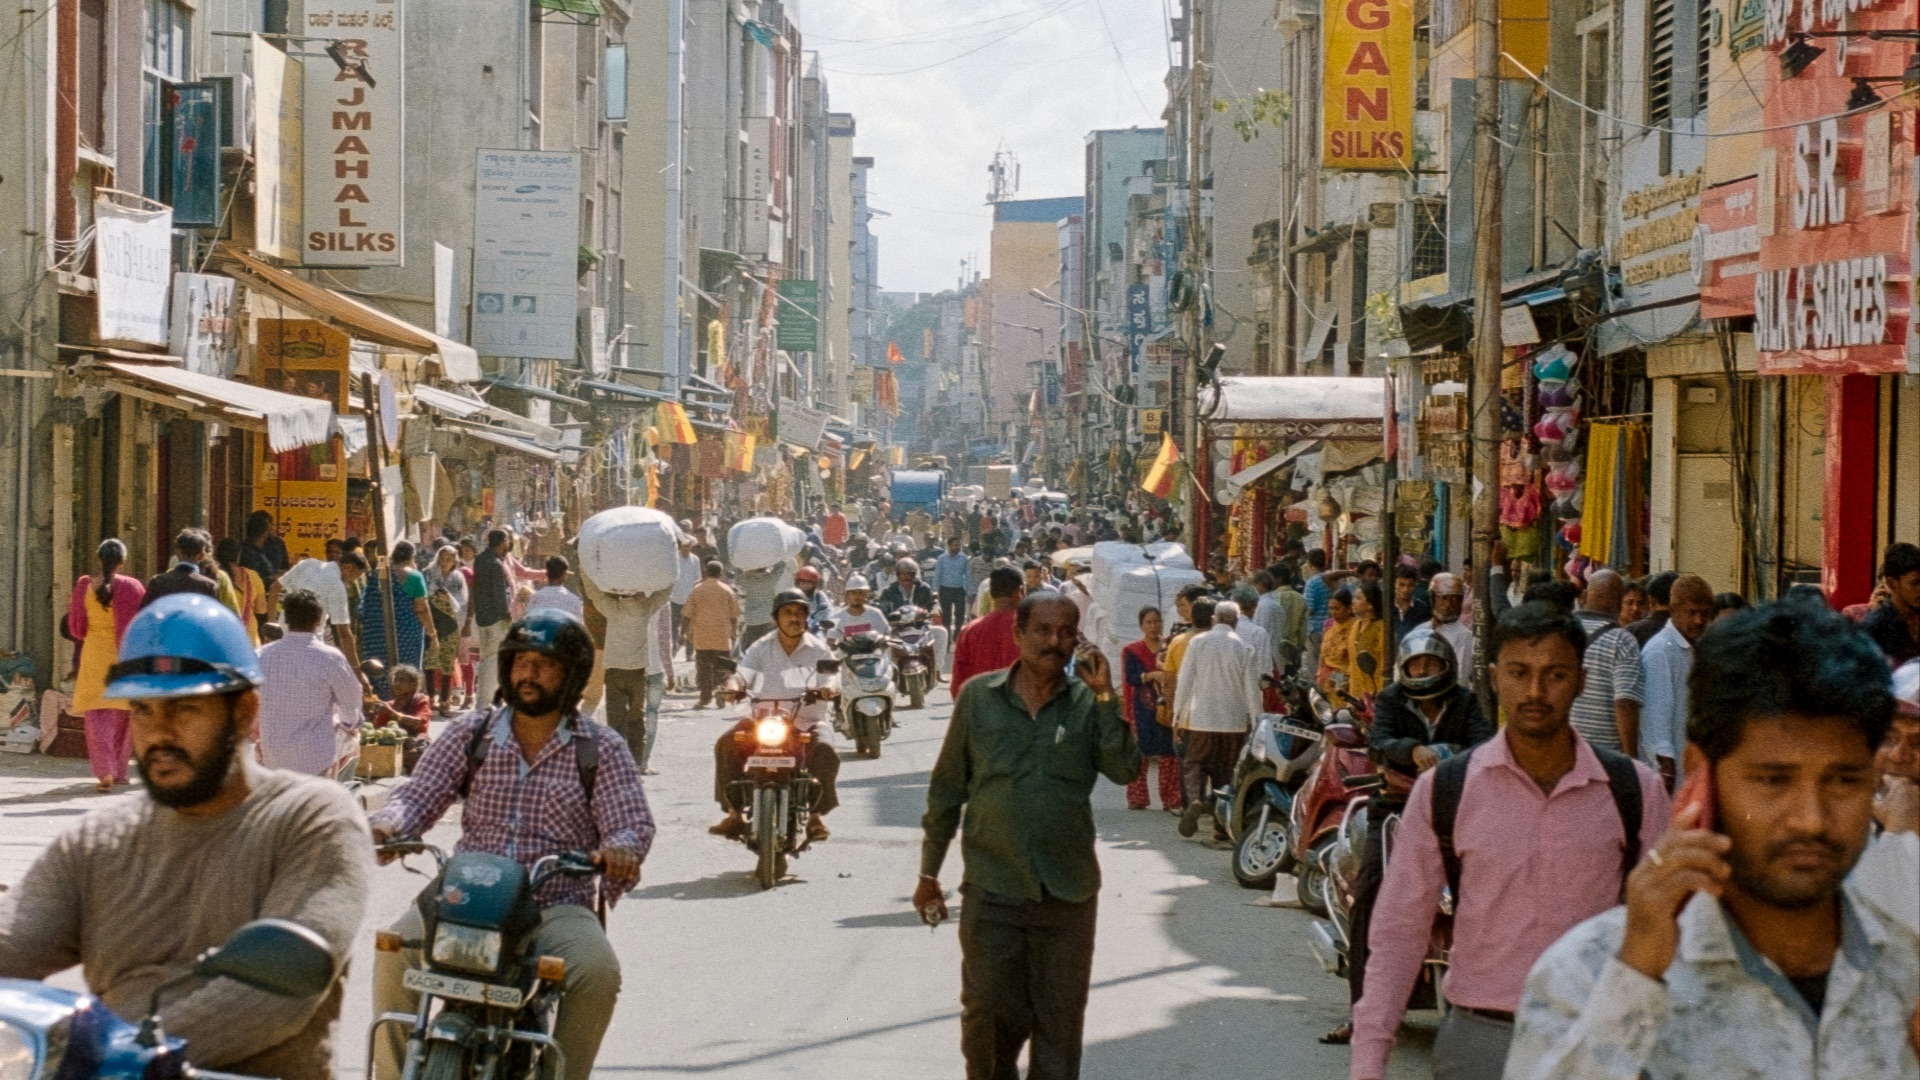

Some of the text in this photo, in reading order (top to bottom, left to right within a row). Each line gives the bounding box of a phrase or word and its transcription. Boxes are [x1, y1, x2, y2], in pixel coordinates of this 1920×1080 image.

[333, 39, 371, 227] RAJMAHAL
[1331, 130, 1404, 158] SILKS
[1793, 118, 1846, 230] S.R.
[308, 231, 395, 252] SILKS
[1753, 267, 1790, 351] SILK
[1812, 253, 1886, 349] SAREES
